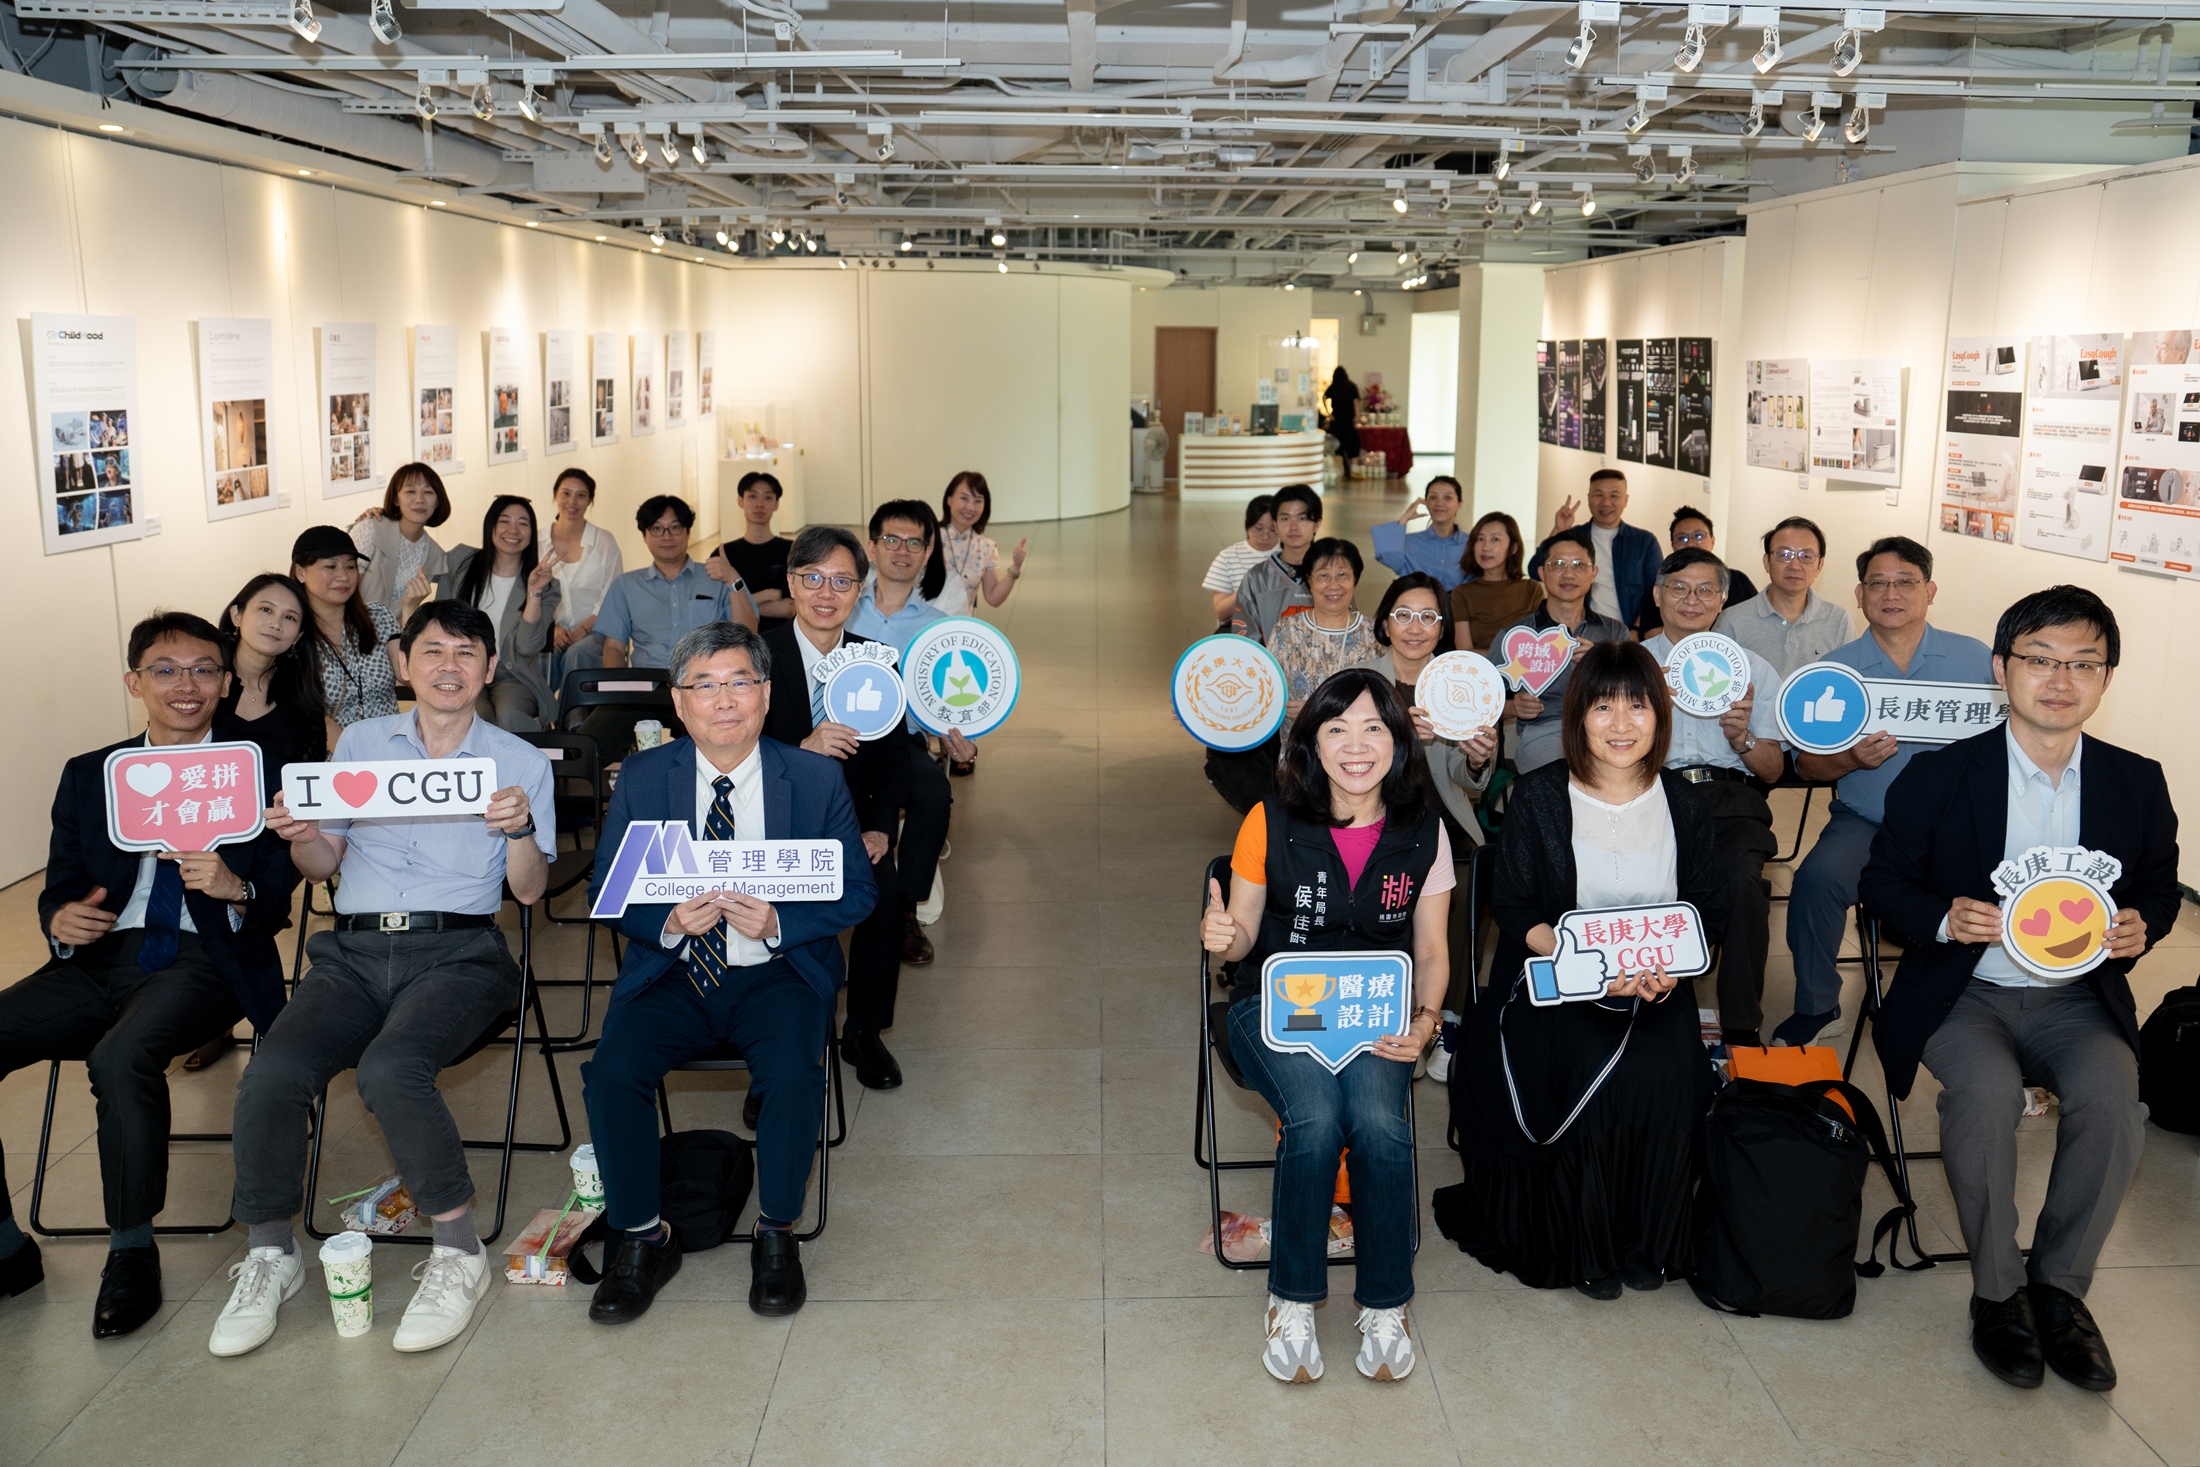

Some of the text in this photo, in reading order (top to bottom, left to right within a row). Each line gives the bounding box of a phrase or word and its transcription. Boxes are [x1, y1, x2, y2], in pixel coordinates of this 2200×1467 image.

[1952, 350, 1981, 361] EasyCough
[2080, 347, 2117, 361] EasyCough
[814, 644, 896, 680] 我的主場秀
[1517, 641, 1551, 658] 跨域
[918, 635, 1002, 707] MINISTRY OF EDUCATION
[1529, 659, 1558, 674] 設計
[1671, 640, 1743, 707] MINISTRY OF EDUCATION
[1701, 680, 1743, 711] 教育部
[937, 700, 991, 723] 教育部
[179, 761, 241, 793] 愛拼
[296, 769, 484, 808] I CGU
[141, 795, 236, 827] 才會贏
[707, 848, 836, 874] 管理學院
[1997, 851, 2117, 895] 長庚工設
[644, 880, 836, 900] College of Management
[1313, 870, 1328, 927] 青年局長
[1289, 884, 1313, 945] 侯佳齡
[1581, 912, 1689, 947] 長庚大學
[1617, 944, 1674, 970] CGU
[1338, 973, 1396, 1000] 醫療
[1336, 1002, 1395, 1030] 設計
